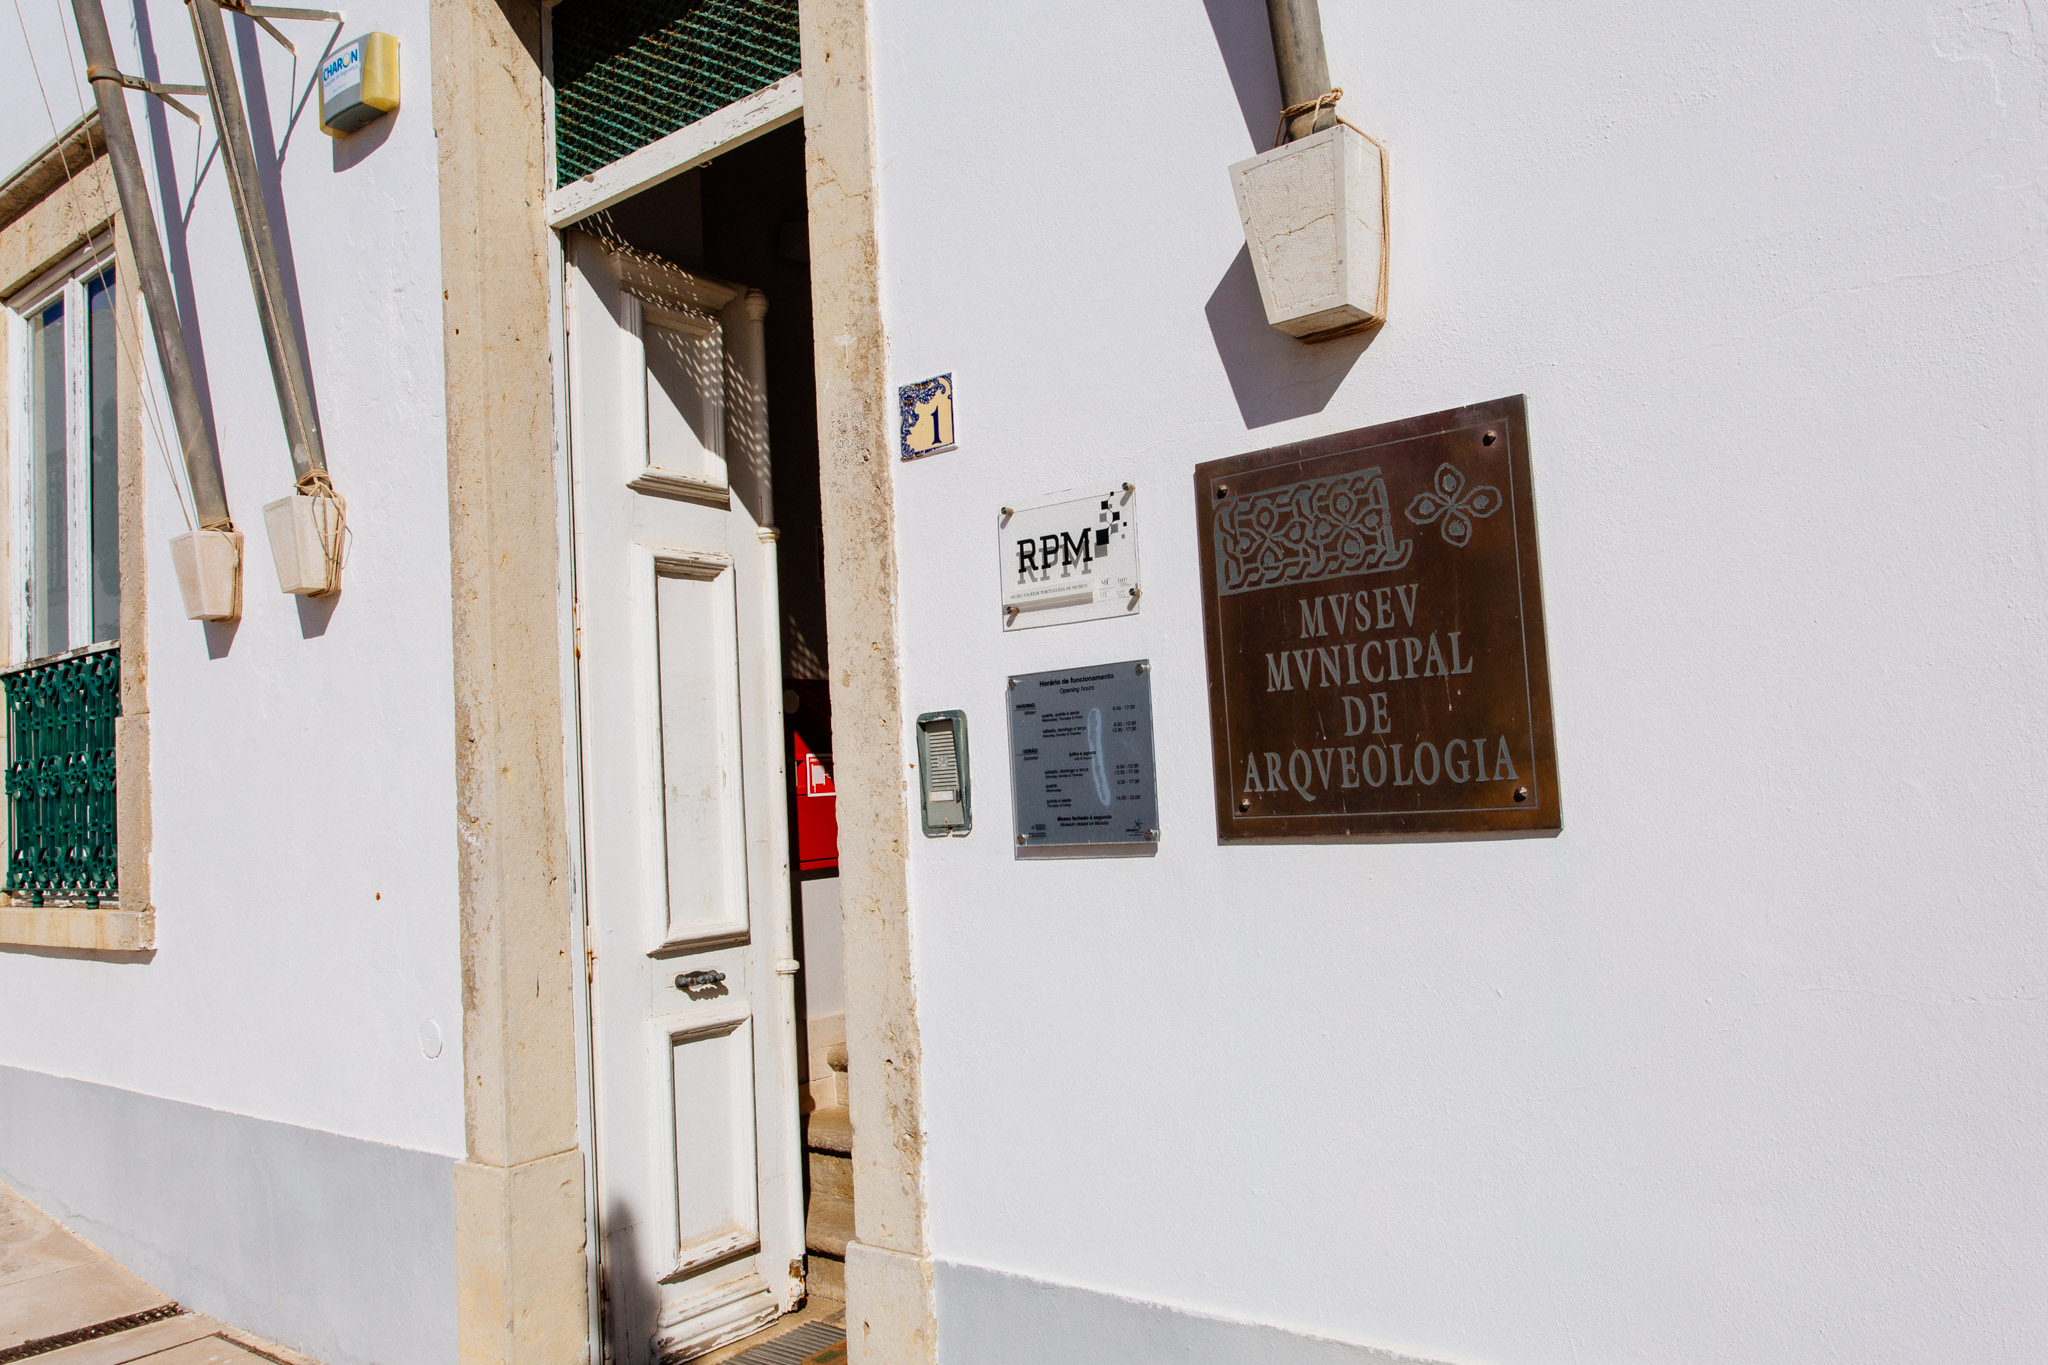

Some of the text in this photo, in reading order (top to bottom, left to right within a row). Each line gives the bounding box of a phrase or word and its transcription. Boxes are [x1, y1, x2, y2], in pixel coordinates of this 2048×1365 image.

[324, 49, 358, 81] CHARON
[931, 405, 942, 445] 1
[1017, 528, 1093, 573] RPM
[1299, 584, 1419, 639] MVSEV
[1039, 679, 1060, 687] Horário
[1071, 673, 1114, 683] funcionamento
[1266, 632, 1472, 692] MVNICIPAL
[1059, 686, 1079, 694] Opening
[1343, 693, 1391, 736] DE
[1244, 734, 1519, 802] ARQVEOLOGIA
